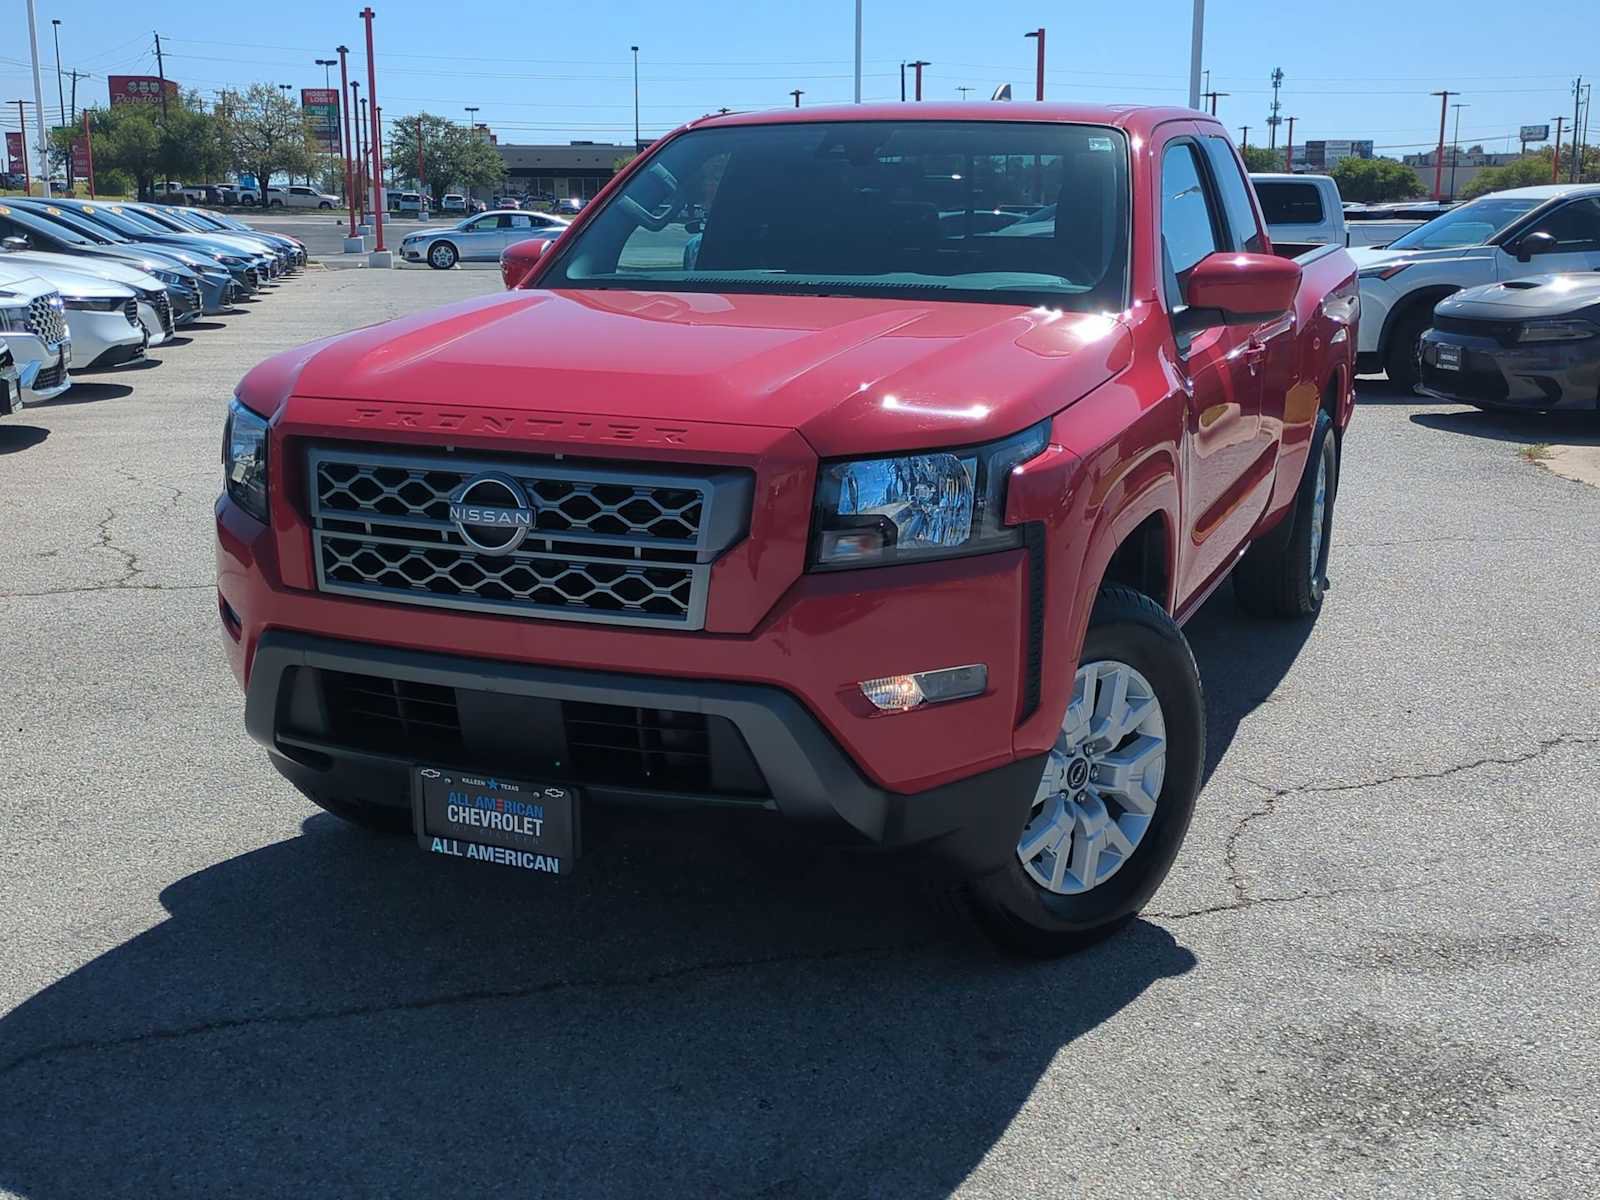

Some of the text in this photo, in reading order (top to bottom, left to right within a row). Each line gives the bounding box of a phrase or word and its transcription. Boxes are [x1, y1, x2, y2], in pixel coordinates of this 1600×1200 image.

[347, 408, 688, 444] FRONTIER
[449, 506, 530, 524] NISSAN
[462, 777, 519, 792] KILLEEN TEXAS
[448, 792, 543, 818] ALL AMERICAN
[447, 804, 543, 836] CHEVROLET
[431, 837, 560, 874] ALL AMERICAN
